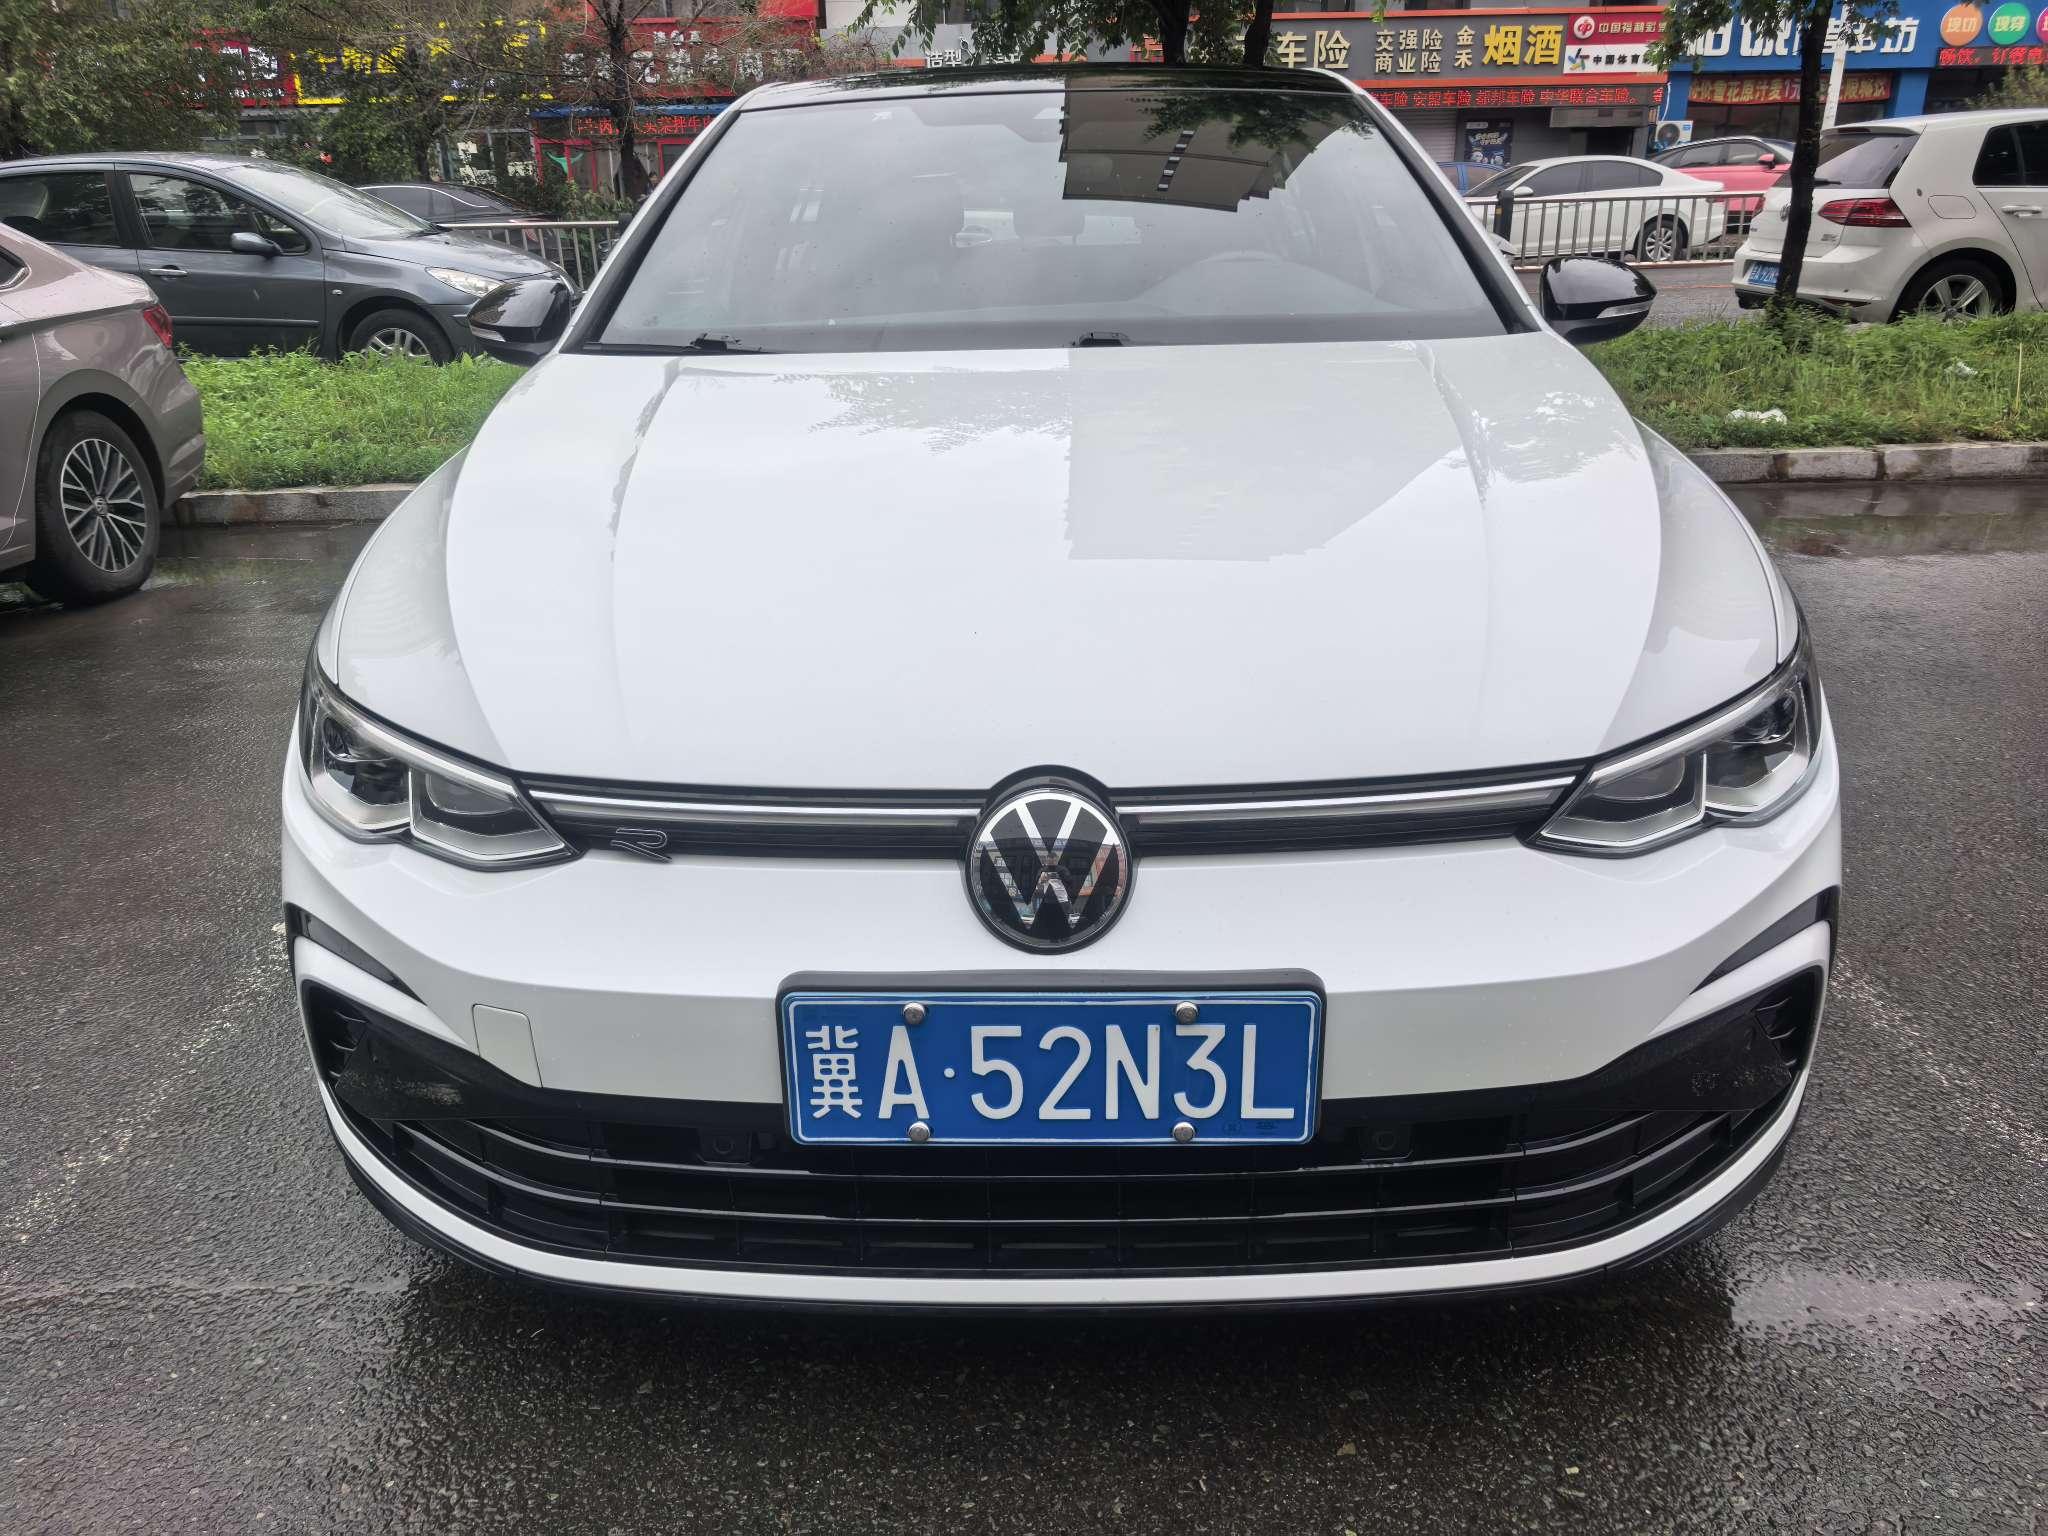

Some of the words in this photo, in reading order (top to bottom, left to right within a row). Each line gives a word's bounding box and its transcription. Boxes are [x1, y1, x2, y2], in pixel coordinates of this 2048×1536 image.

[1375, 28, 1443, 51] 交强险
[1483, 24, 1564, 66] 烟酒
[1374, 51, 1441, 73] 商业险
[804, 1023, 1296, 1121] 冀A·52N3L
